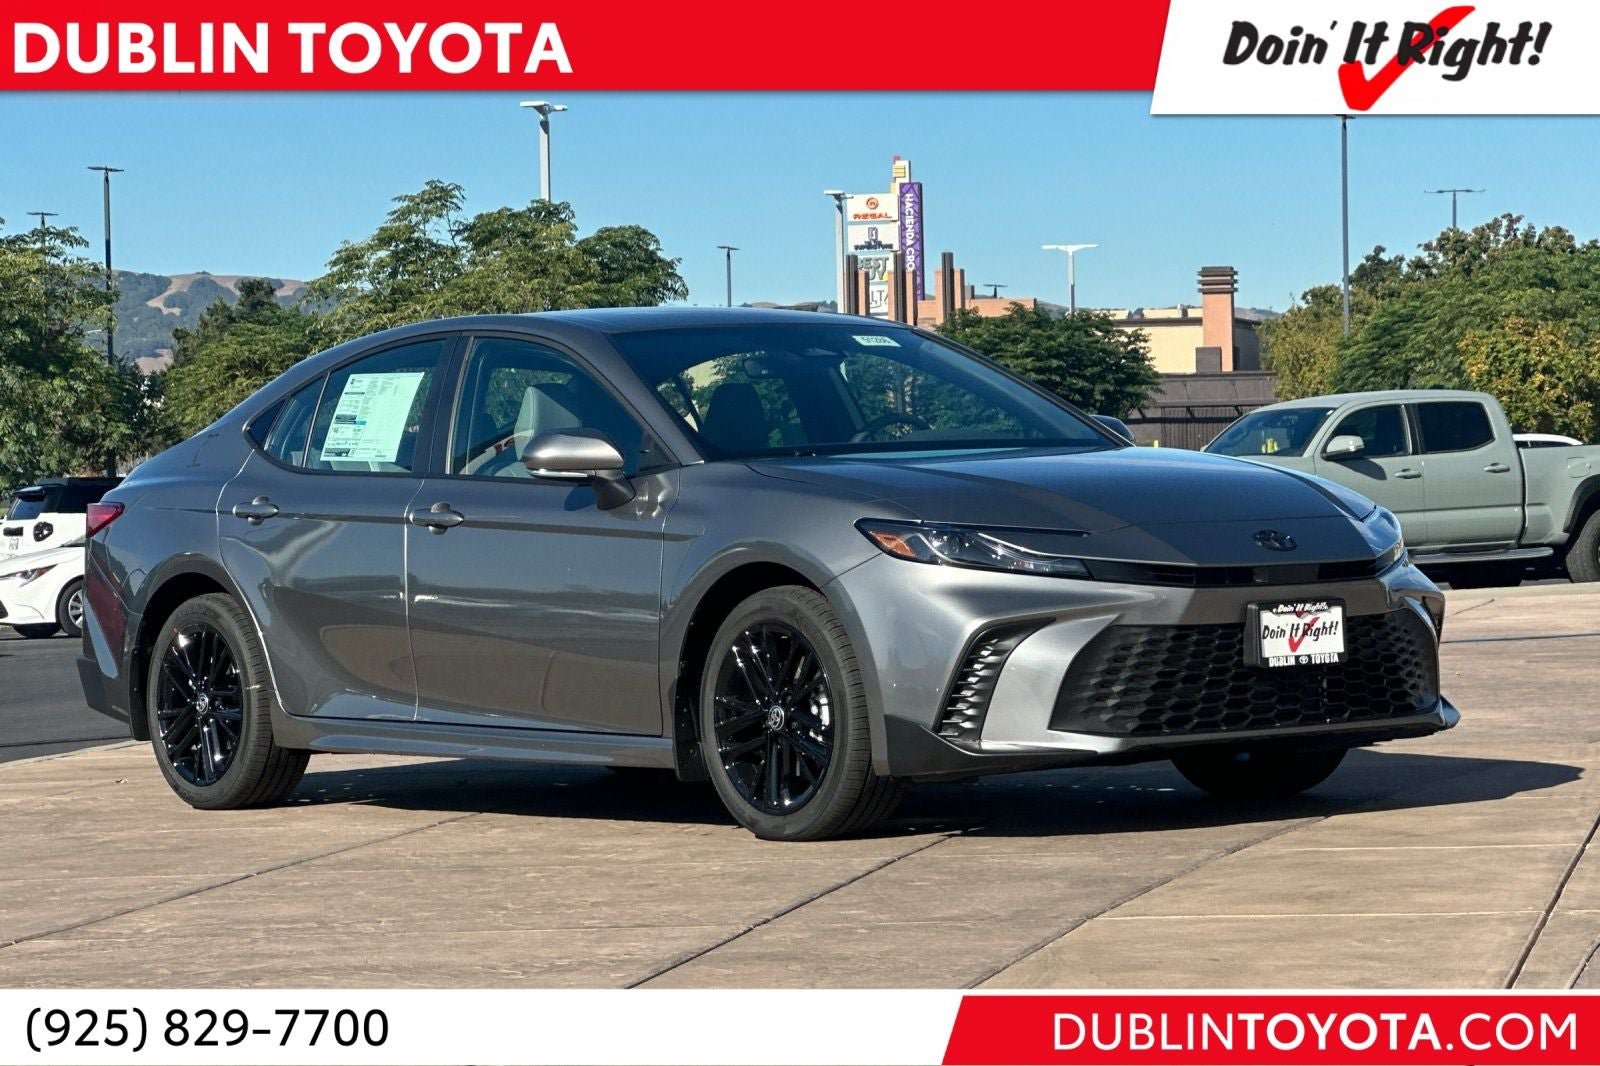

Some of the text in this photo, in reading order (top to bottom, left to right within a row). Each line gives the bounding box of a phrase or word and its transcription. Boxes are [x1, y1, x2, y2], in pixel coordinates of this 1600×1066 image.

[905, 193, 915, 270] HACIENDA CRO
[1290, 622, 1300, 638] It
[1302, 620, 1339, 642] Right!
[1268, 652, 1340, 668] DUBLIN TOYOTA
